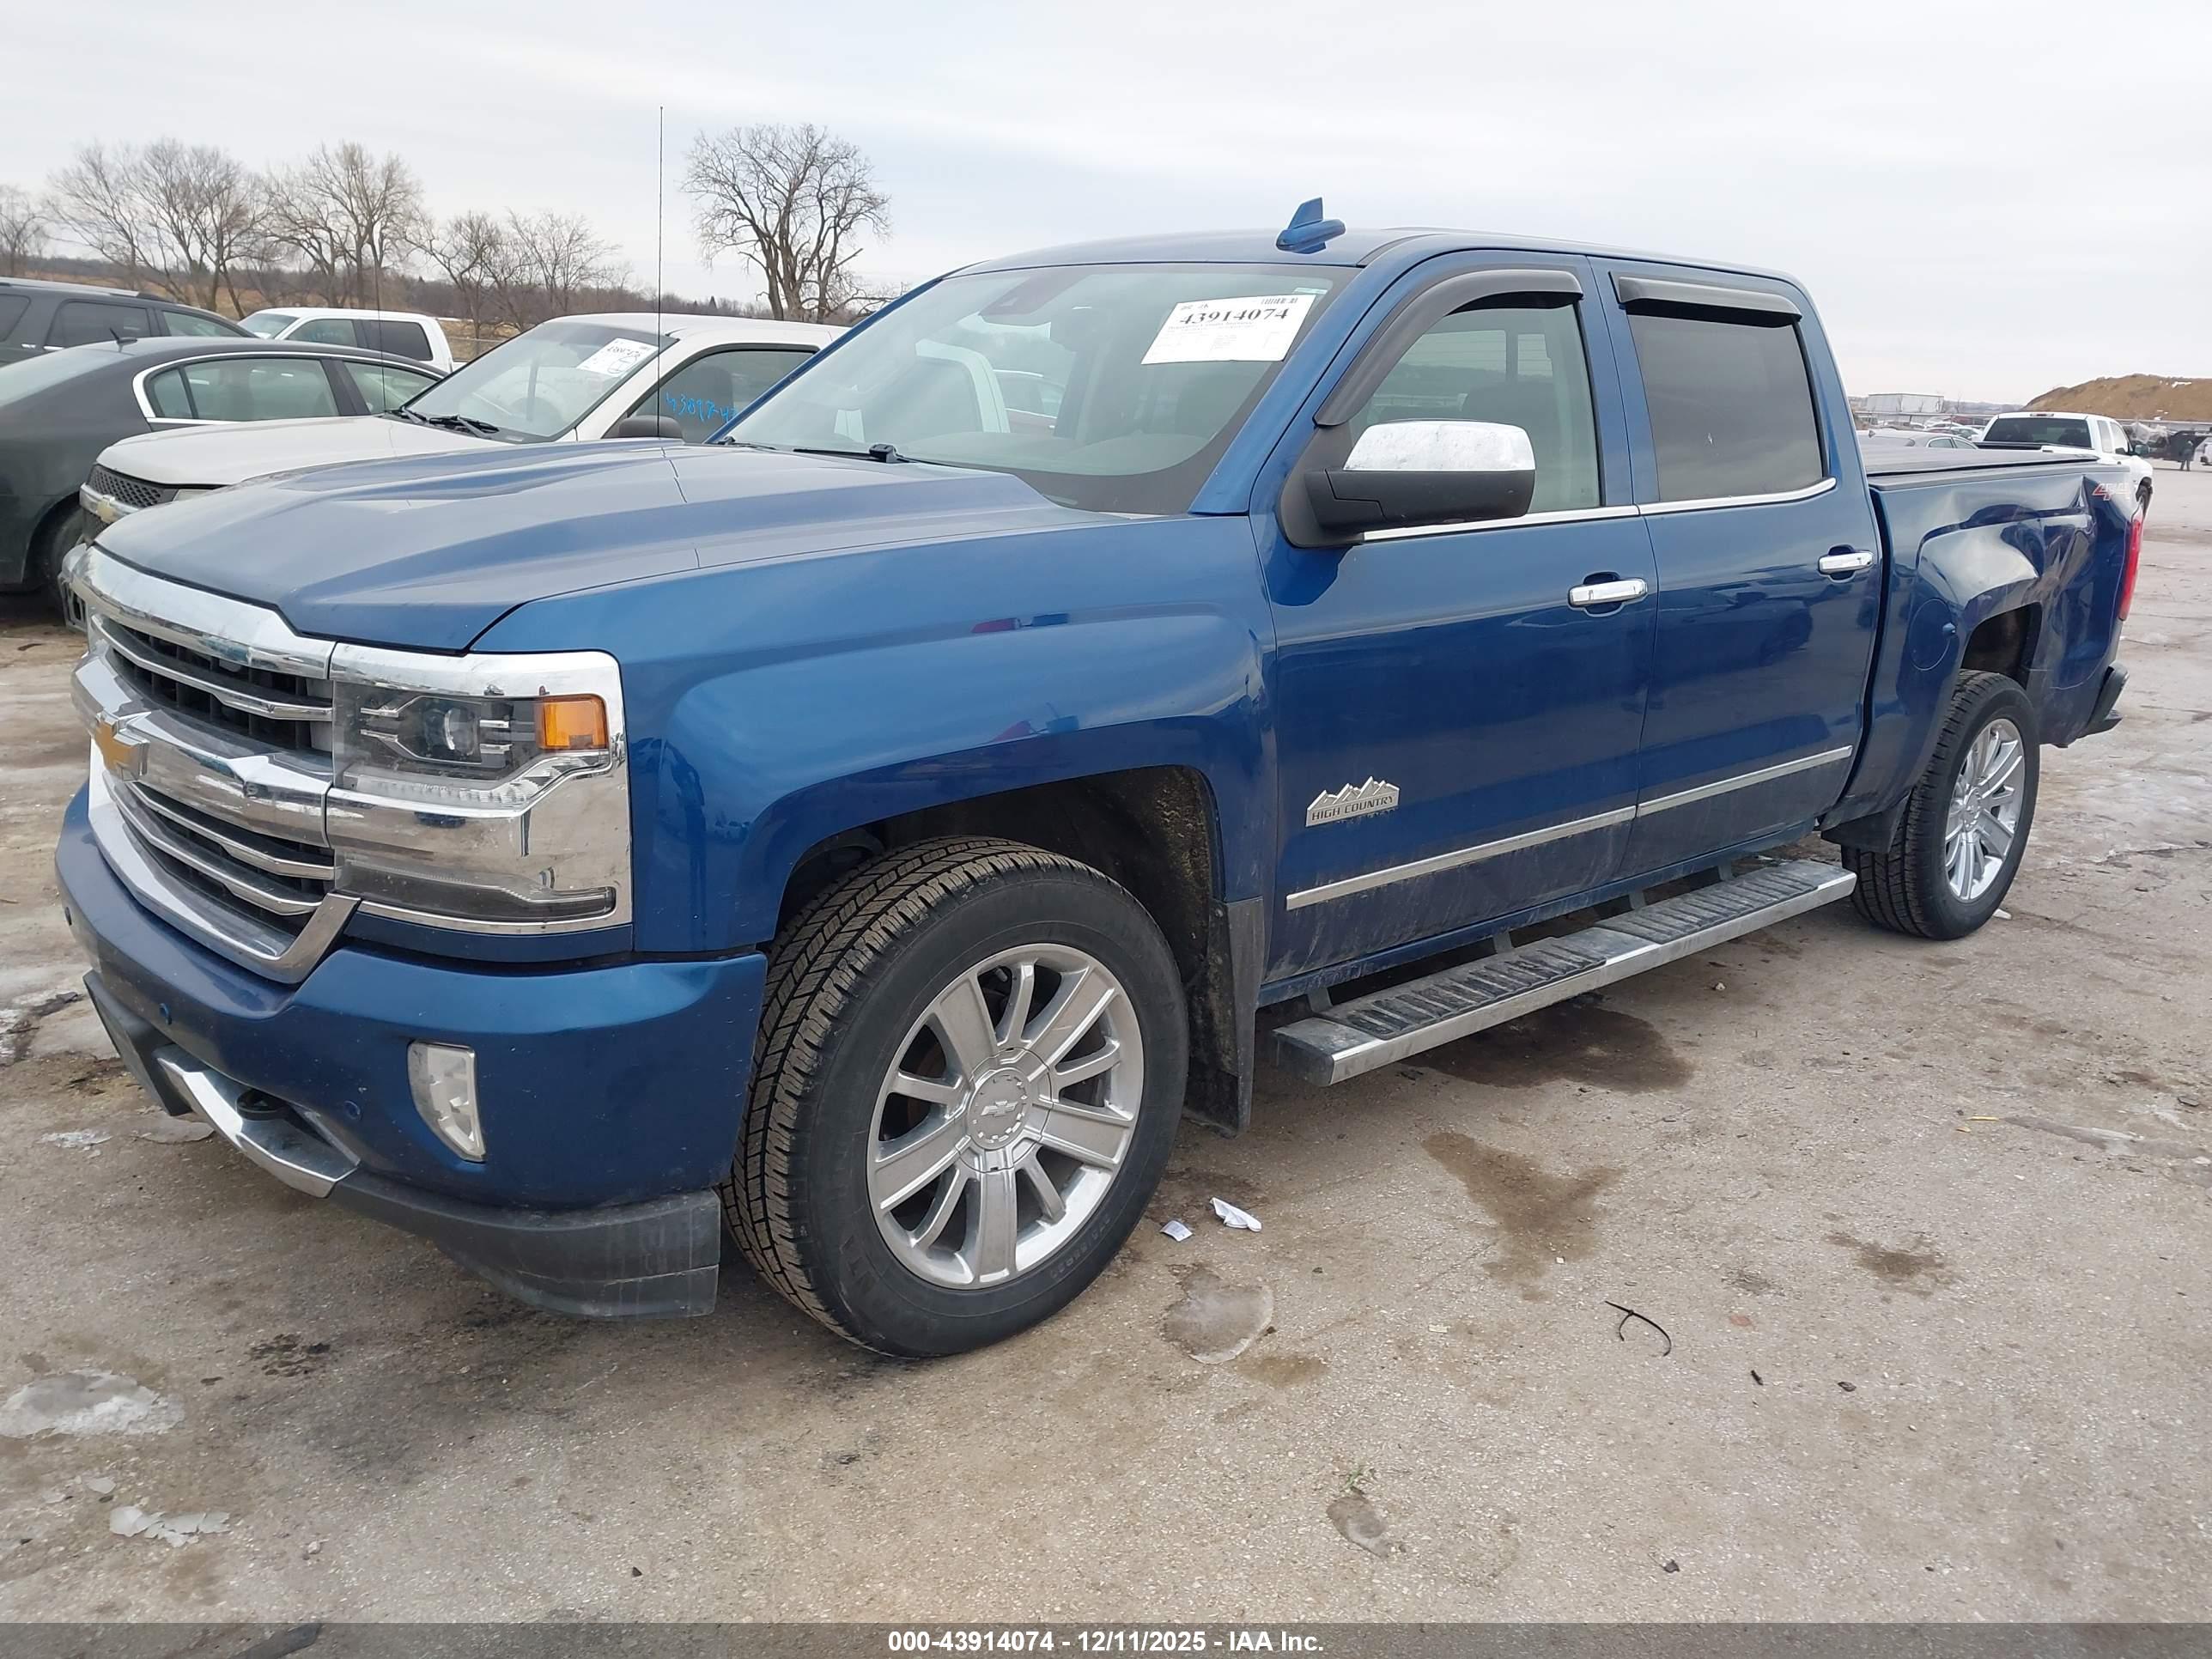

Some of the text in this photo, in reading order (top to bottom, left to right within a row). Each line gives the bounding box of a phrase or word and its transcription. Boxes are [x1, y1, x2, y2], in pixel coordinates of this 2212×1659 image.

[1179, 307, 1289, 325] 43914074
[1311, 795, 1395, 821] HIGH COUNTRY
